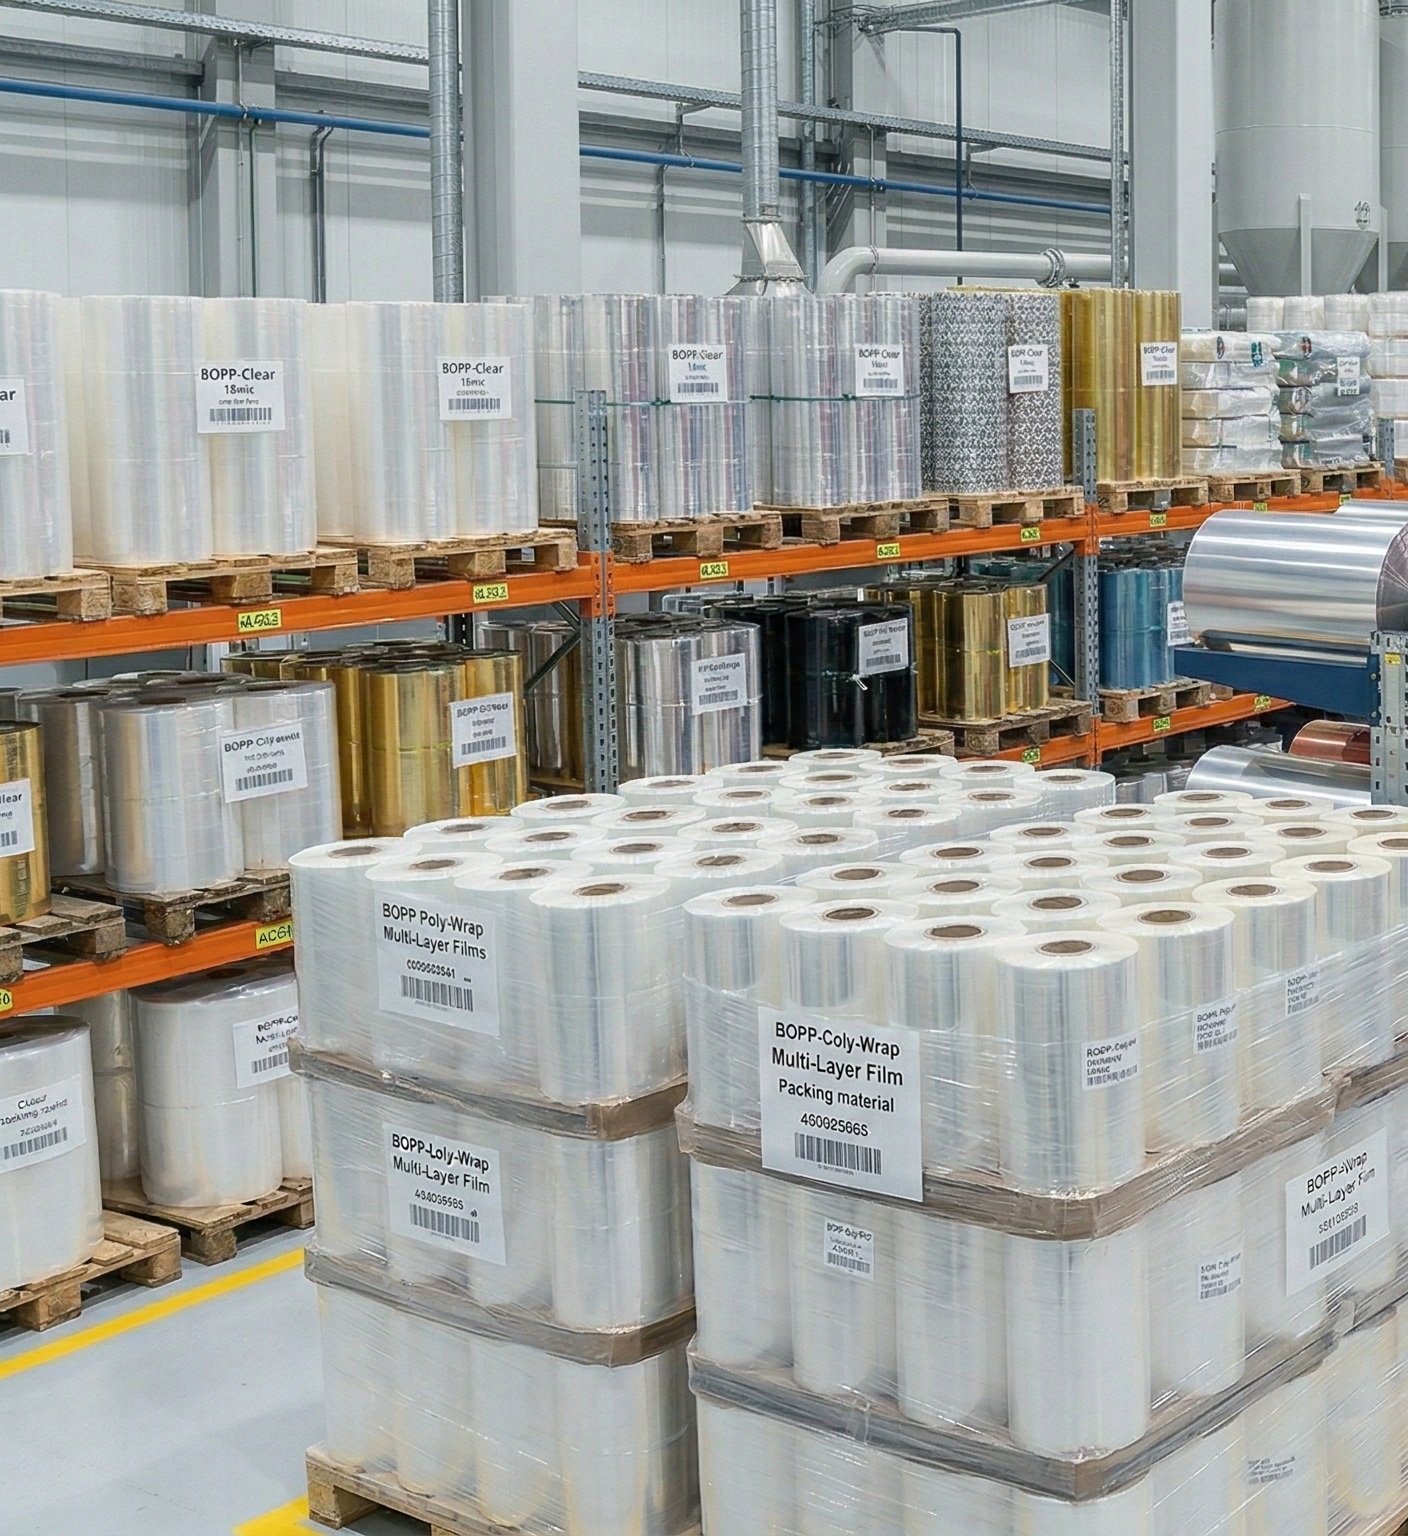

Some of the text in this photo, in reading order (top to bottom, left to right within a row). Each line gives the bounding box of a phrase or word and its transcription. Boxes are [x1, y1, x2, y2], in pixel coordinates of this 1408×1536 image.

[201, 367, 276, 381] BOPP-Clear
[442, 362, 504, 374] BOPP-Clear
[224, 739, 254, 752] BOPP
[382, 903, 484, 940] BOPP Poly-Wrap
[383, 926, 487, 960] Multi-Layer Films
[775, 1022, 900, 1060] BOPP-Coly-Wrap
[772, 1047, 903, 1086] Multi-Layer Film
[778, 1079, 895, 1113] Packing material
[463, 1173, 490, 1194] Film
